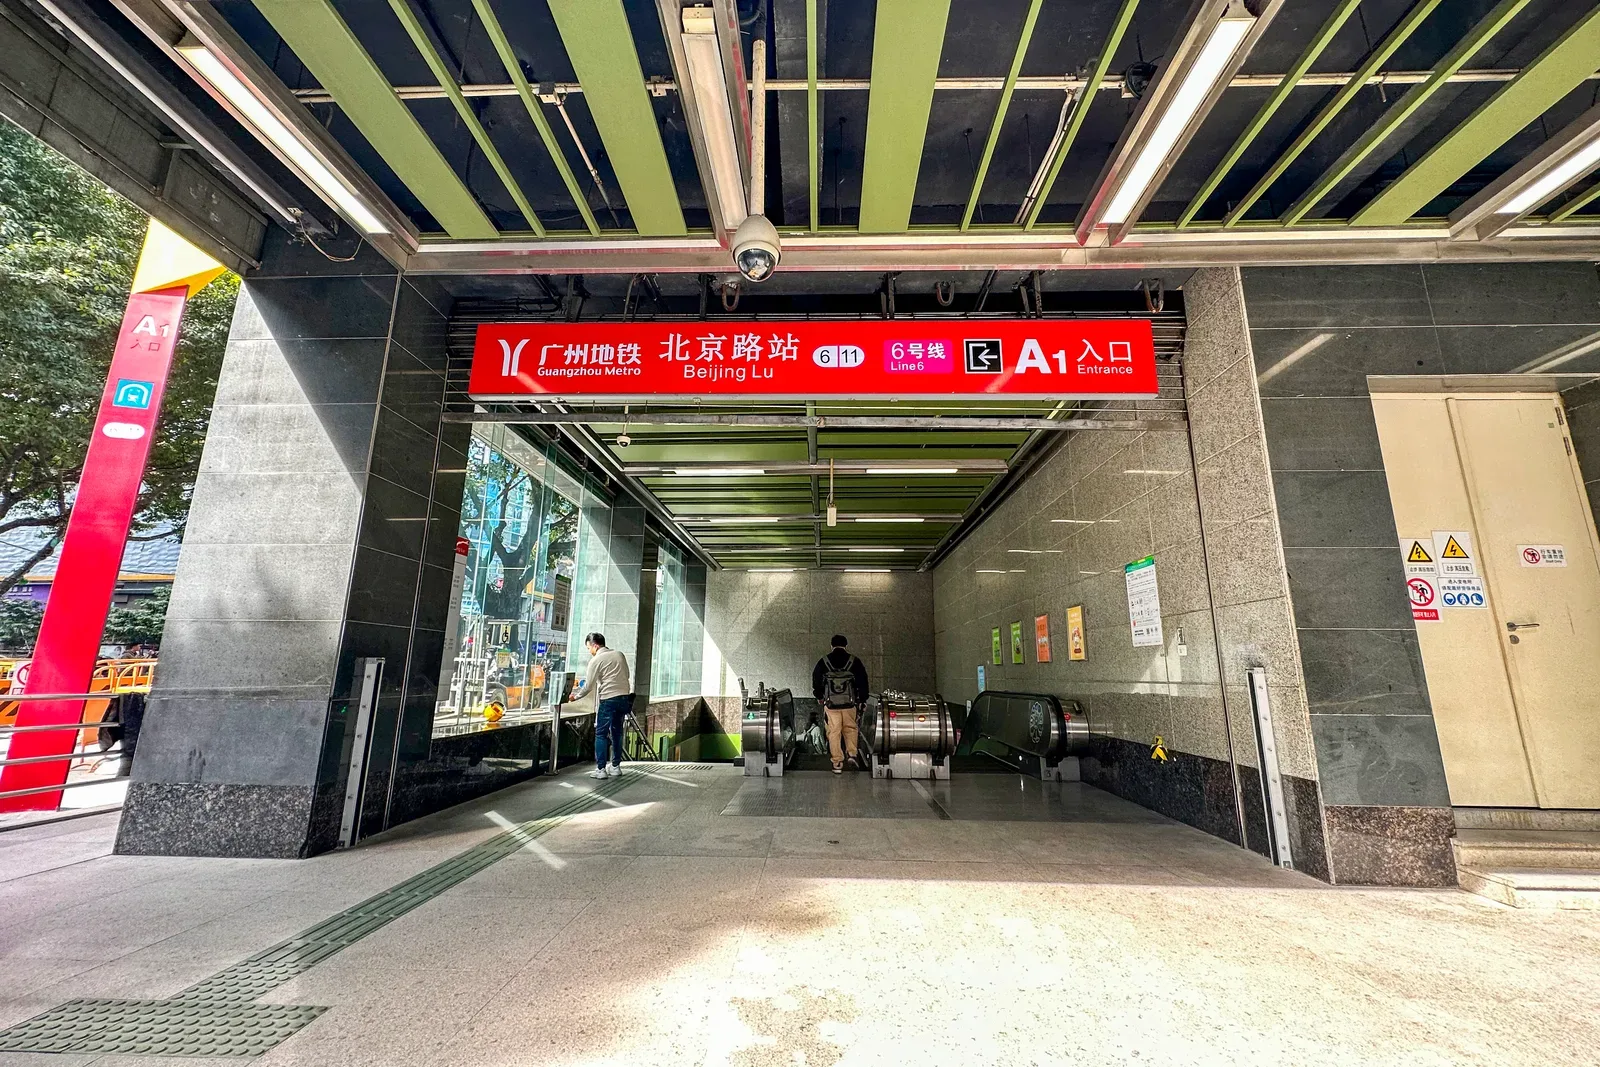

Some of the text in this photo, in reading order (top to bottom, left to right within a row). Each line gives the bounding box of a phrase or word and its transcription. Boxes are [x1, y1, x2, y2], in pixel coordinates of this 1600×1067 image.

[131, 314, 170, 338] A1
[130, 339, 161, 352] 入口
[538, 343, 642, 366] 广州地铁
[659, 332, 800, 362] 北京路站
[891, 342, 946, 360] 6号线
[1076, 338, 1133, 362] 入口
[819, 349, 858, 364] 6 11
[1014, 338, 1067, 374] A1
[537, 366, 642, 378] Guangzhou Metro
[683, 364, 774, 382] Beijing Lu
[1077, 364, 1133, 375] Entrance
